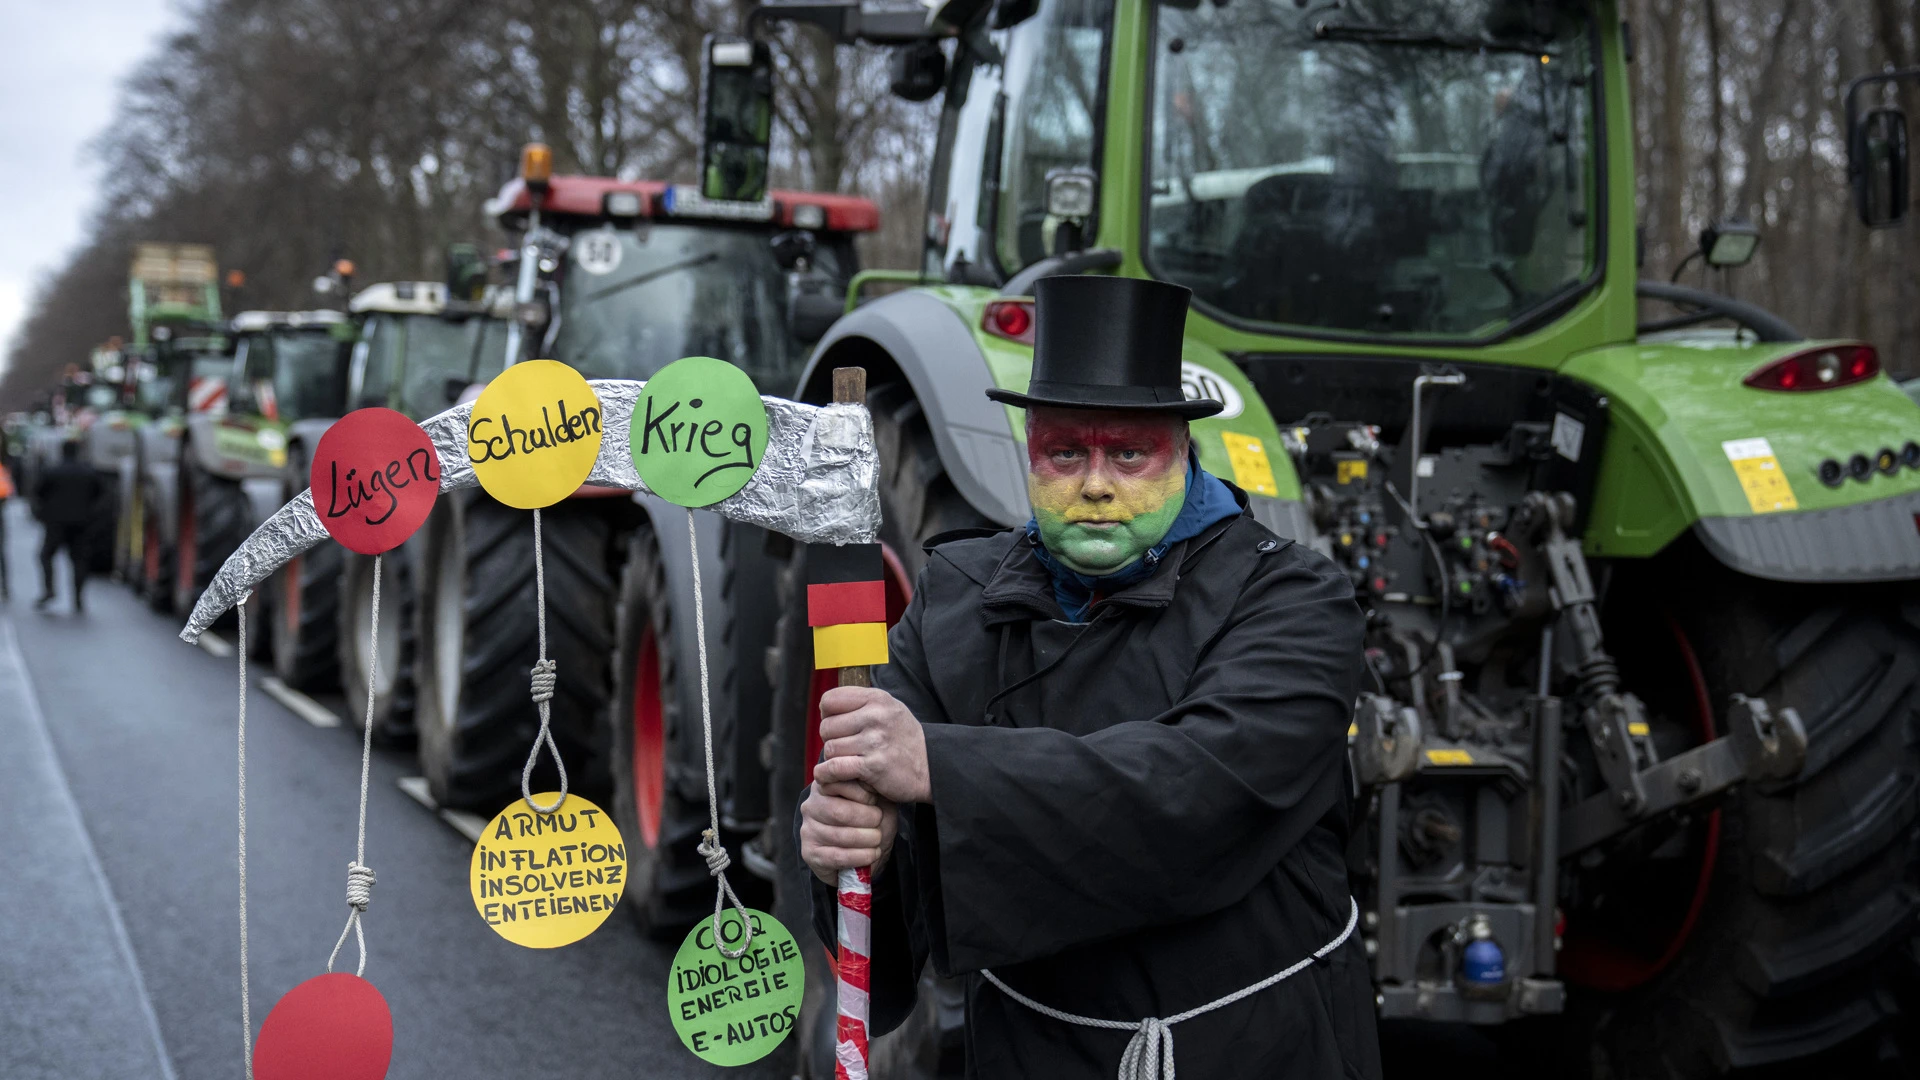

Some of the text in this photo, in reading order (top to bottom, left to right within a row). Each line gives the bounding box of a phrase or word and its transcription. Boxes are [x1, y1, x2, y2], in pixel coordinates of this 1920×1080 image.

[469, 400, 602, 464] Schulden
[641, 396, 755, 489] Krieg
[328, 449, 438, 526] Lügen
[495, 808, 600, 840] ARMUT
[692, 1005, 797, 1053] E-AUTOS
